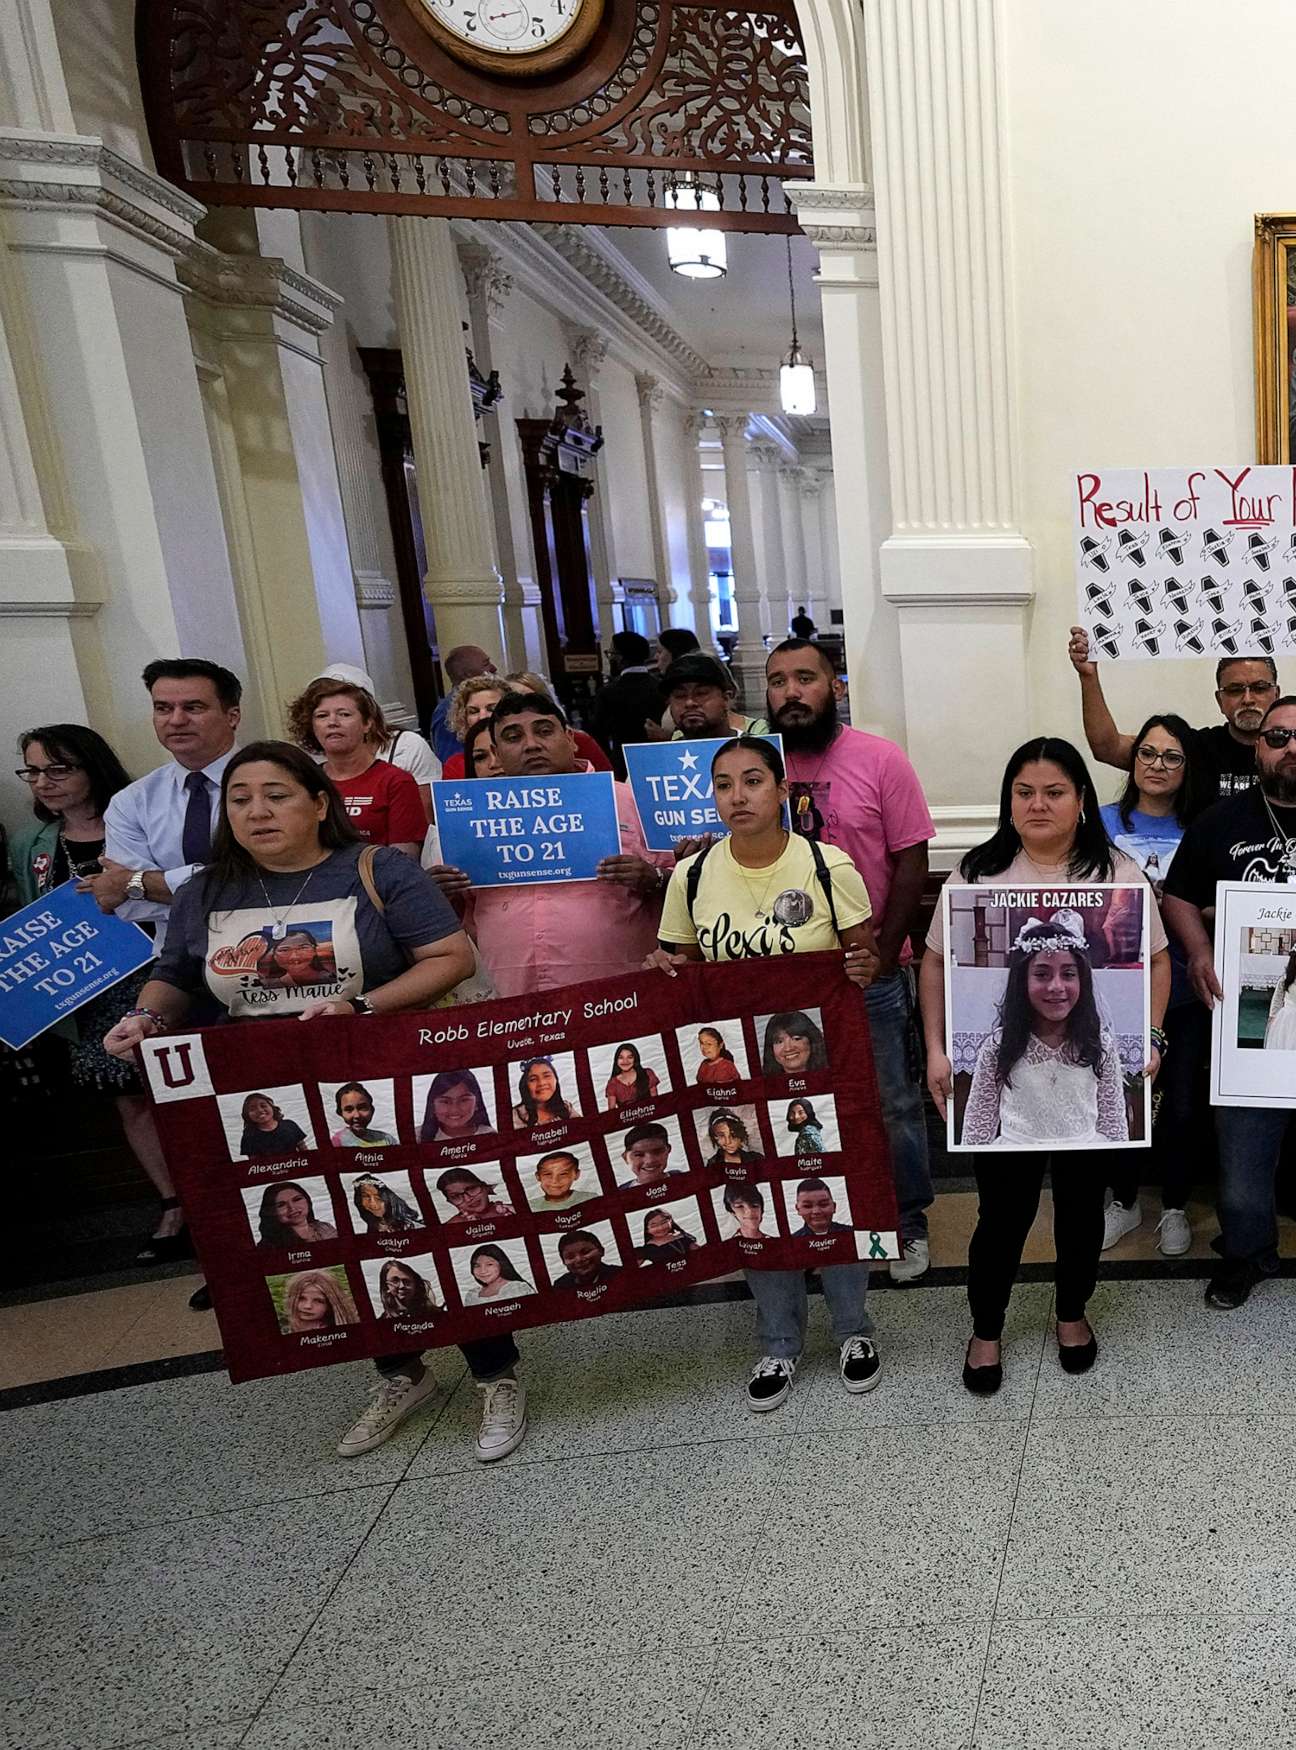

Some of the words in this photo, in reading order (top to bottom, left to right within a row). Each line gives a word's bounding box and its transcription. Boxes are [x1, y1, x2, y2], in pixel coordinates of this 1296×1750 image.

[531, 17, 545, 37] 5
[1077, 472, 1163, 529] Result
[1173, 472, 1205, 521] of
[1214, 467, 1283, 522] Your
[444, 798, 472, 808] TEXAS
[485, 788, 563, 811] RAISE
[470, 817, 525, 838] THE
[532, 814, 584, 835] AGE
[654, 811, 686, 826] GUN
[497, 843, 534, 864] TO
[541, 841, 566, 861] 21
[1229, 841, 1265, 861] Forever
[1266, 837, 1283, 853] In
[498, 866, 572, 881] txgunsense.org
[990, 892, 1039, 908] JACKIE
[1042, 891, 1104, 908] CAZARES
[1257, 906, 1292, 921] Jackie
[49, 920, 99, 959] AGE
[33, 968, 76, 996] TO
[73, 951, 103, 974] 21
[54, 966, 120, 1010] txgunsense.org
[236, 988, 280, 1005] Tess
[286, 983, 345, 999] Marie
[418, 1026, 469, 1045] Robb
[477, 1009, 572, 1038] Elementary
[584, 991, 638, 1018] School
[539, 1031, 566, 1043] Texas
[153, 1042, 195, 1089] U
[788, 1078, 806, 1087] Eva
[619, 1103, 656, 1120] Eliahna
[440, 1143, 477, 1156] Amerie
[248, 1159, 308, 1175] Alexandria
[725, 1167, 747, 1176] Layla
[555, 1211, 582, 1224] Jayce
[465, 1222, 496, 1235] Jailah
[808, 1238, 837, 1248] Xavier
[288, 1250, 312, 1261] Irma
[666, 1259, 687, 1271] Tess
[484, 1302, 521, 1316] Nevaeh
[300, 1331, 348, 1346] Makenna
